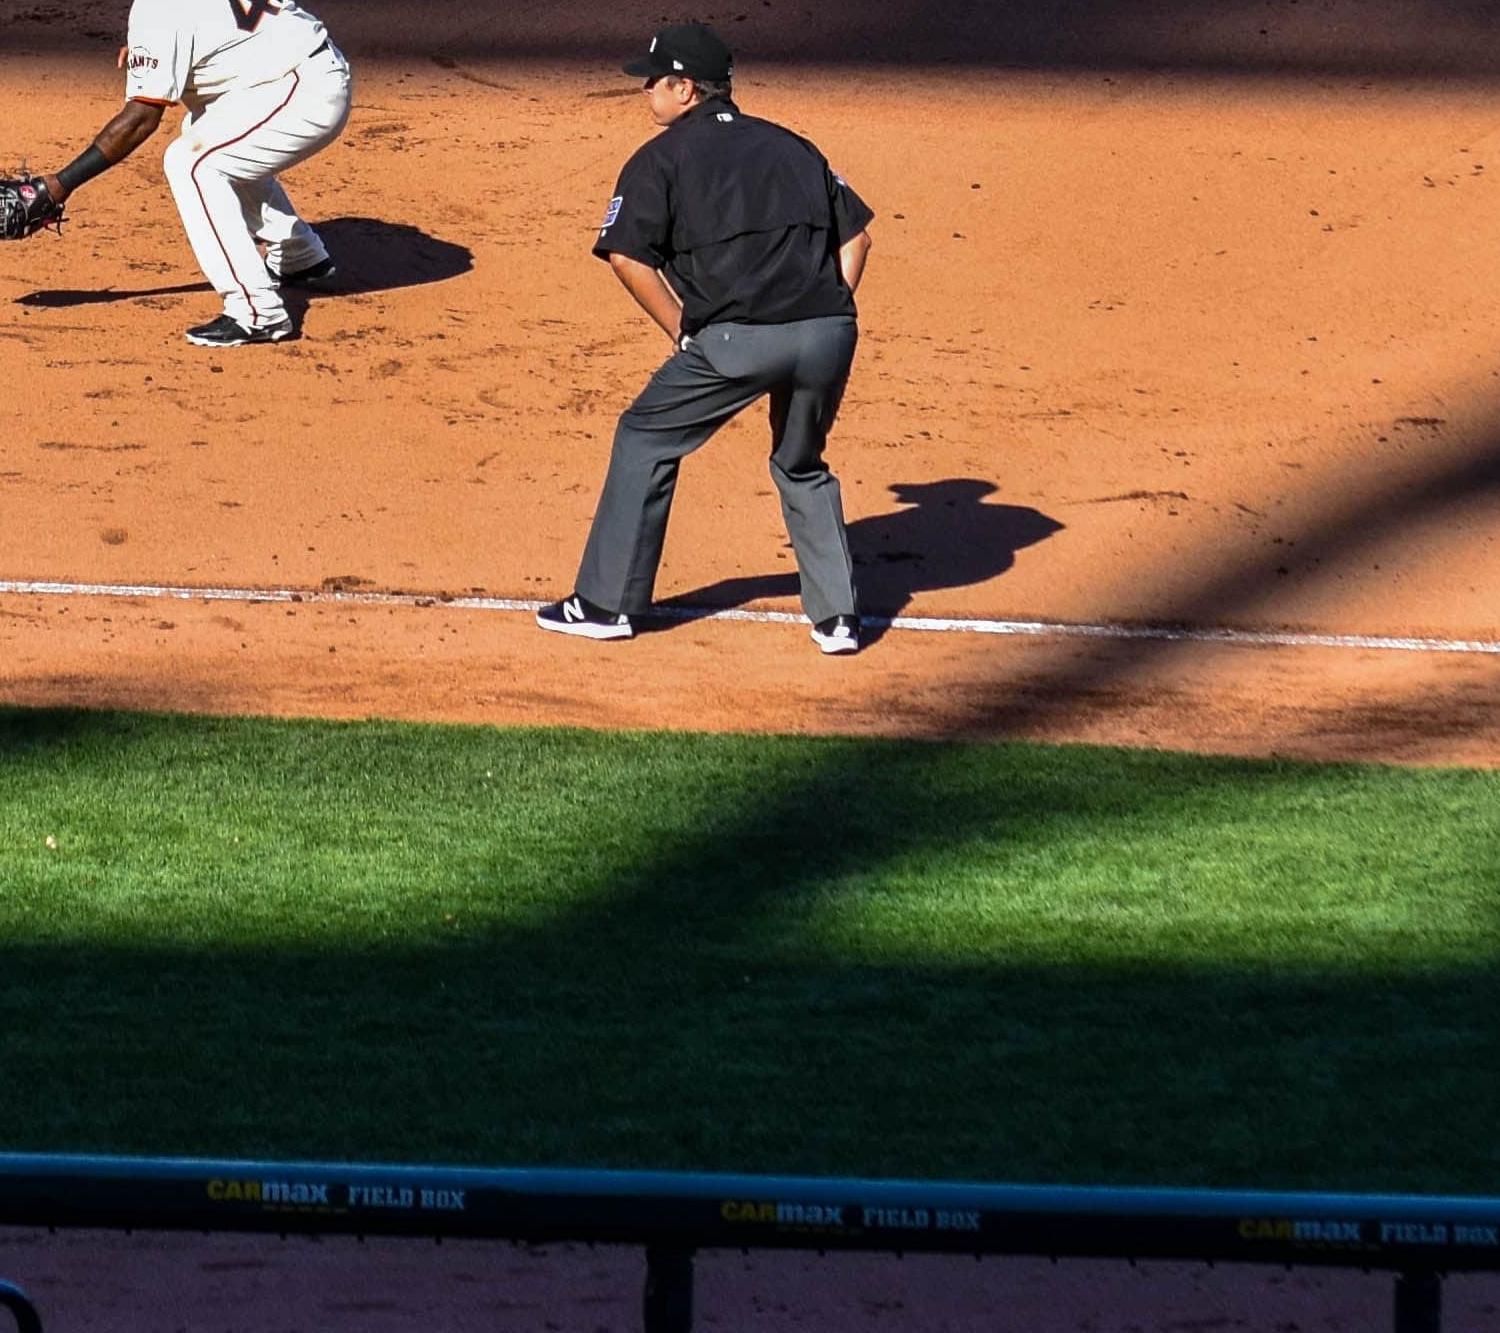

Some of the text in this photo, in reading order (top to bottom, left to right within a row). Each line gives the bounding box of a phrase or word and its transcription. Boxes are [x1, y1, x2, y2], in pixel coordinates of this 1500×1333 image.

[347, 1184, 414, 1210] FIELD
[420, 1187, 466, 1211] BOX
[862, 1204, 930, 1229] FIELD
[936, 1208, 982, 1232] BOX
[1380, 1222, 1448, 1245] FIELD
[1454, 1224, 1500, 1246] BOX
